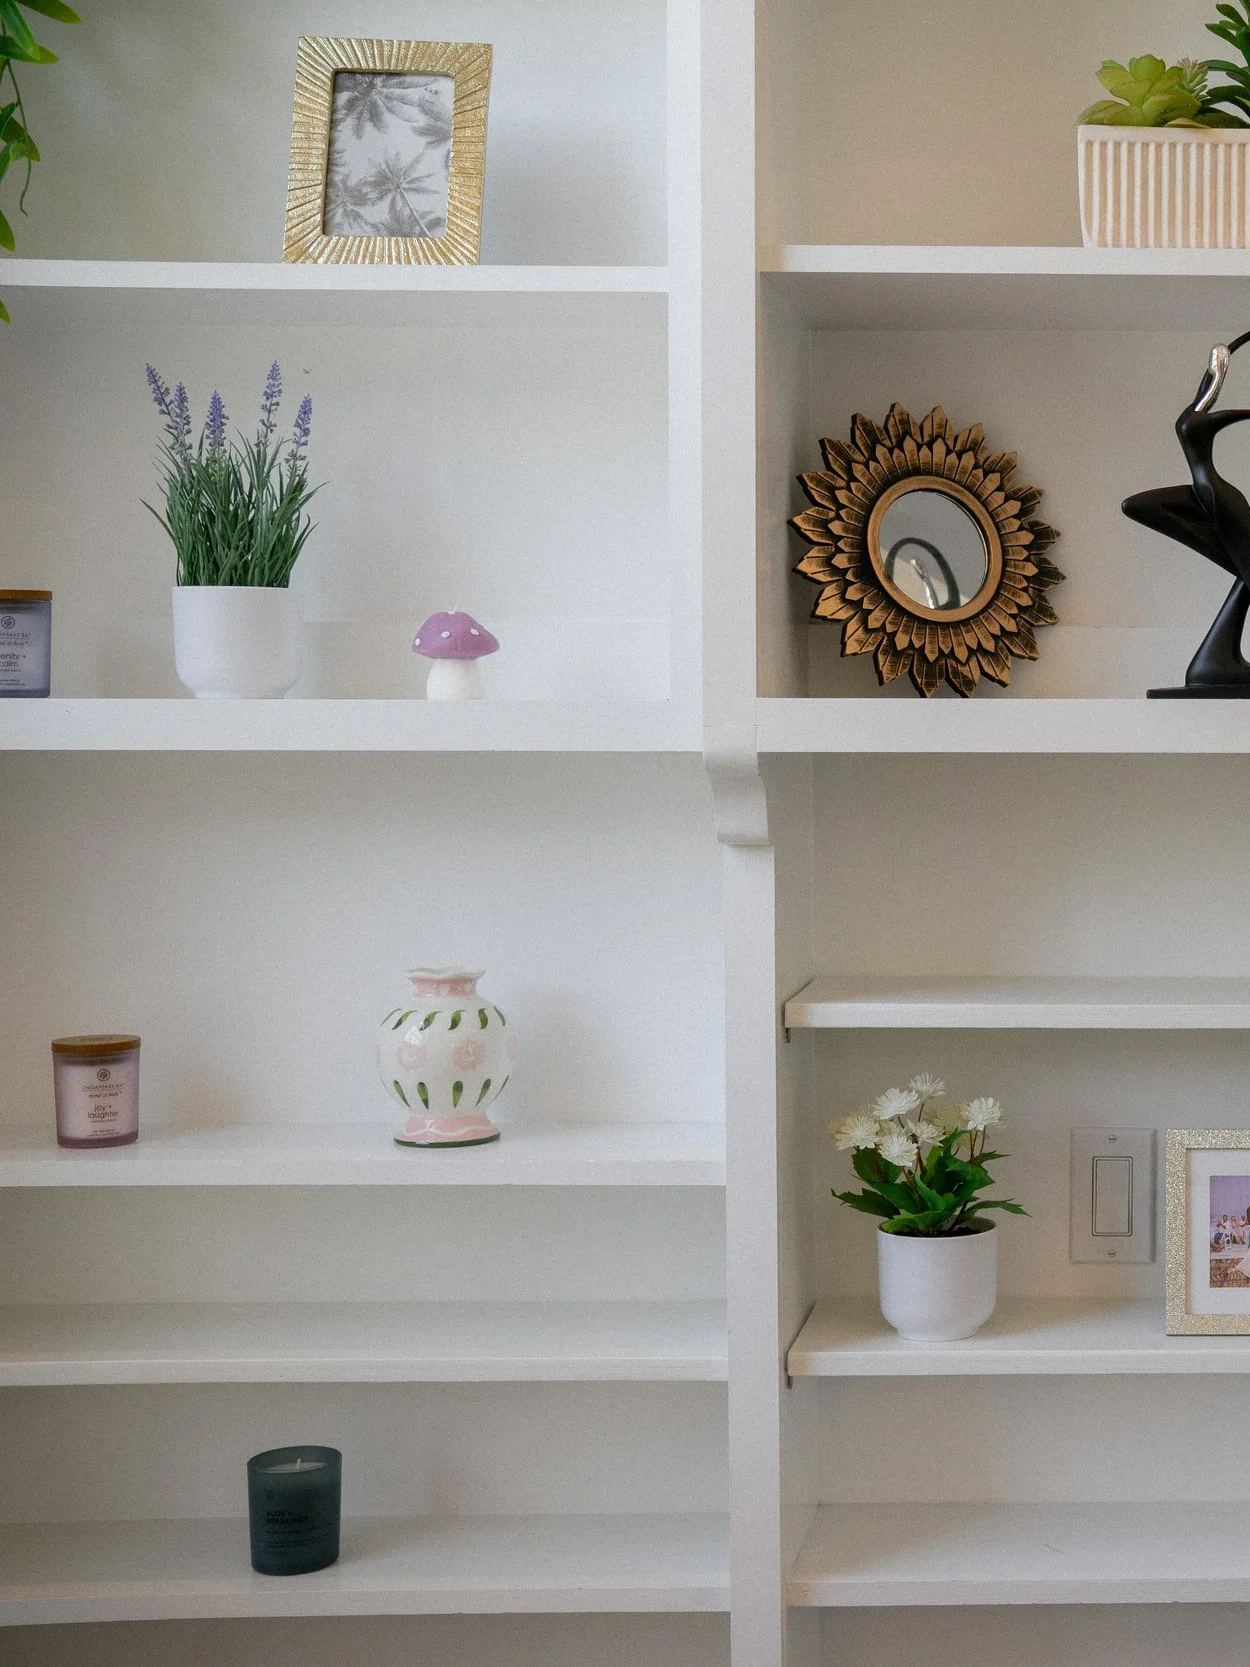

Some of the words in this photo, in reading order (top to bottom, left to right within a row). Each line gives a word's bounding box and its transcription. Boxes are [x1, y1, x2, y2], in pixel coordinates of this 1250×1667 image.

[0, 653, 20, 661] enity
[94, 1103, 106, 1112] joy
[87, 1110, 120, 1119] laughter
